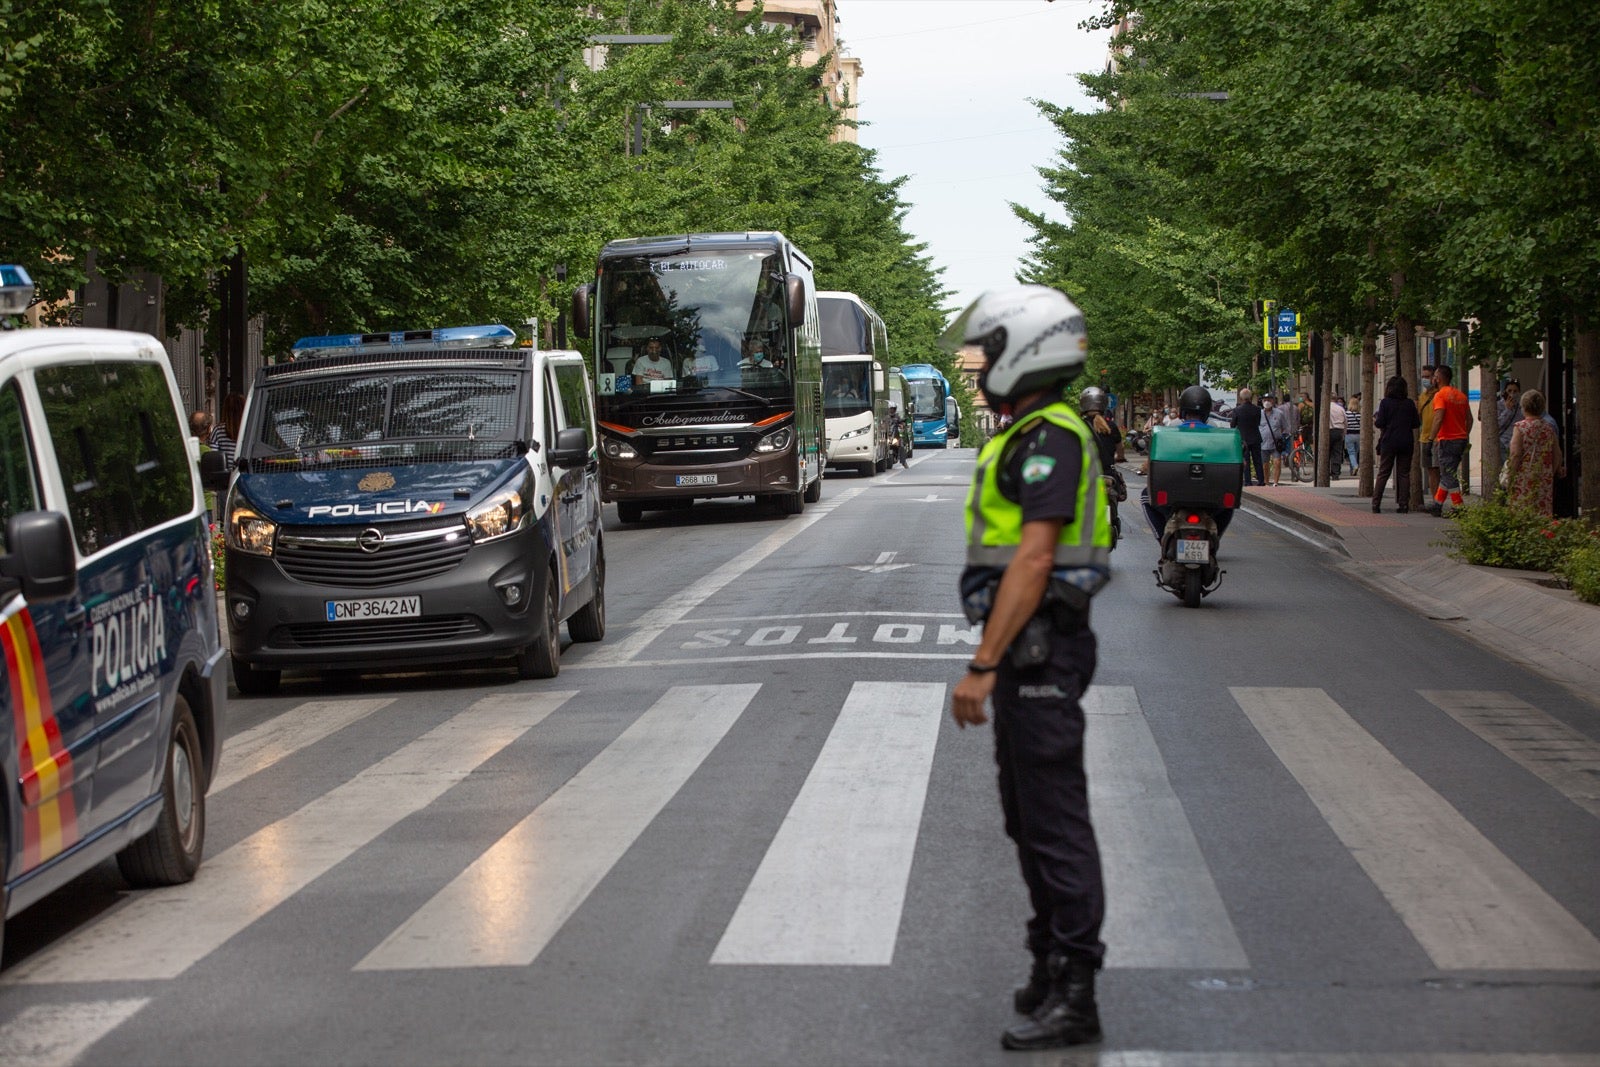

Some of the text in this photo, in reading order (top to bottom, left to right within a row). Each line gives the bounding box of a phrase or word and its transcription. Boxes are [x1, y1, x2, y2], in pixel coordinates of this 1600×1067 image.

[642, 411, 745, 426] Autogranadina
[656, 435, 735, 447] SETRA
[308, 498, 431, 518] POLICÍA
[681, 622, 984, 650] MOTOS
